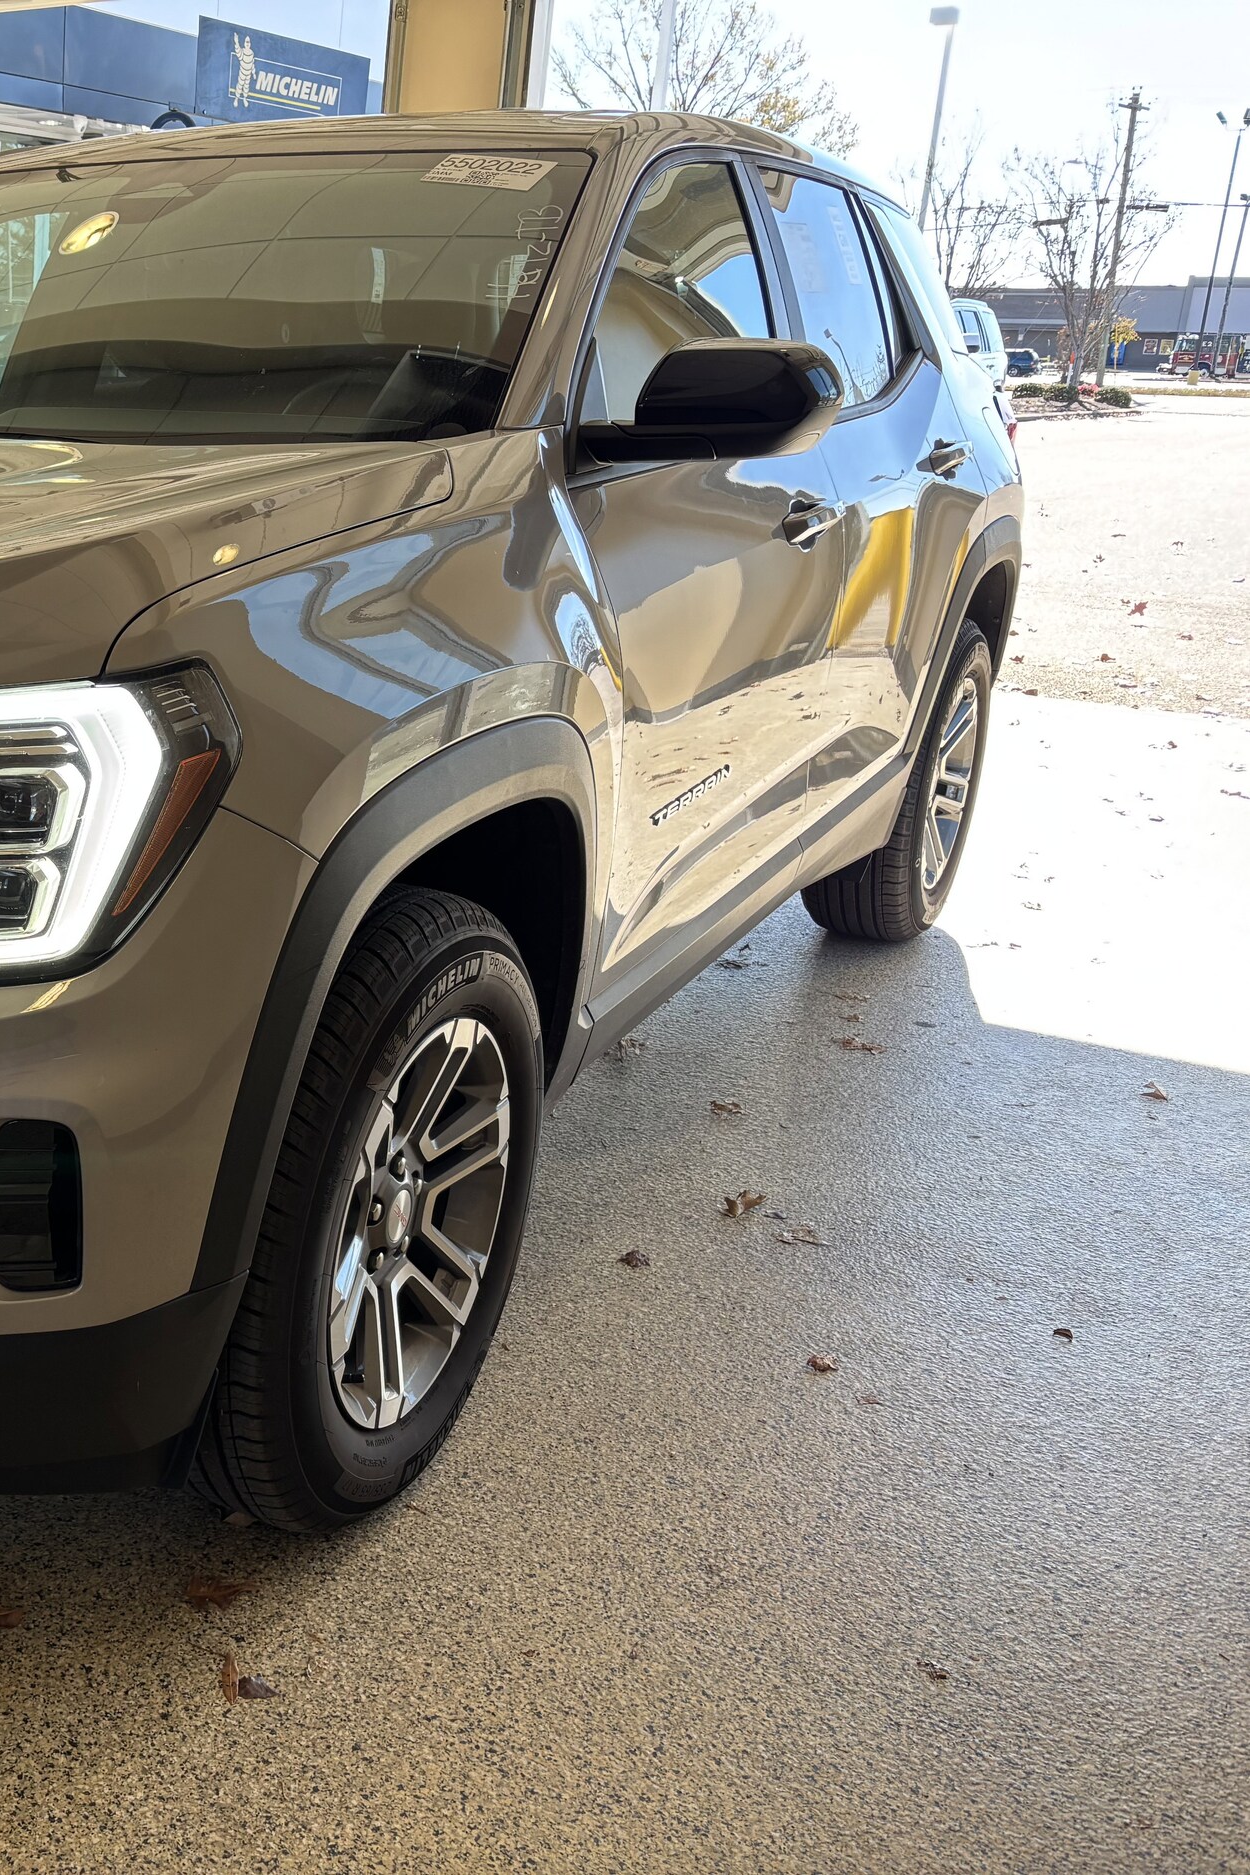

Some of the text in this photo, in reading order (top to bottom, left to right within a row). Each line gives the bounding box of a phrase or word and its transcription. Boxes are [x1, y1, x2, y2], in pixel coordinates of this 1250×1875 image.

[255, 71, 338, 106] MICHELIN
[440, 157, 543, 175] 5502022
[649, 763, 731, 827] TERRAIN
[407, 957, 481, 1037] MICHELIN
[488, 956, 520, 985] PRIMACY
